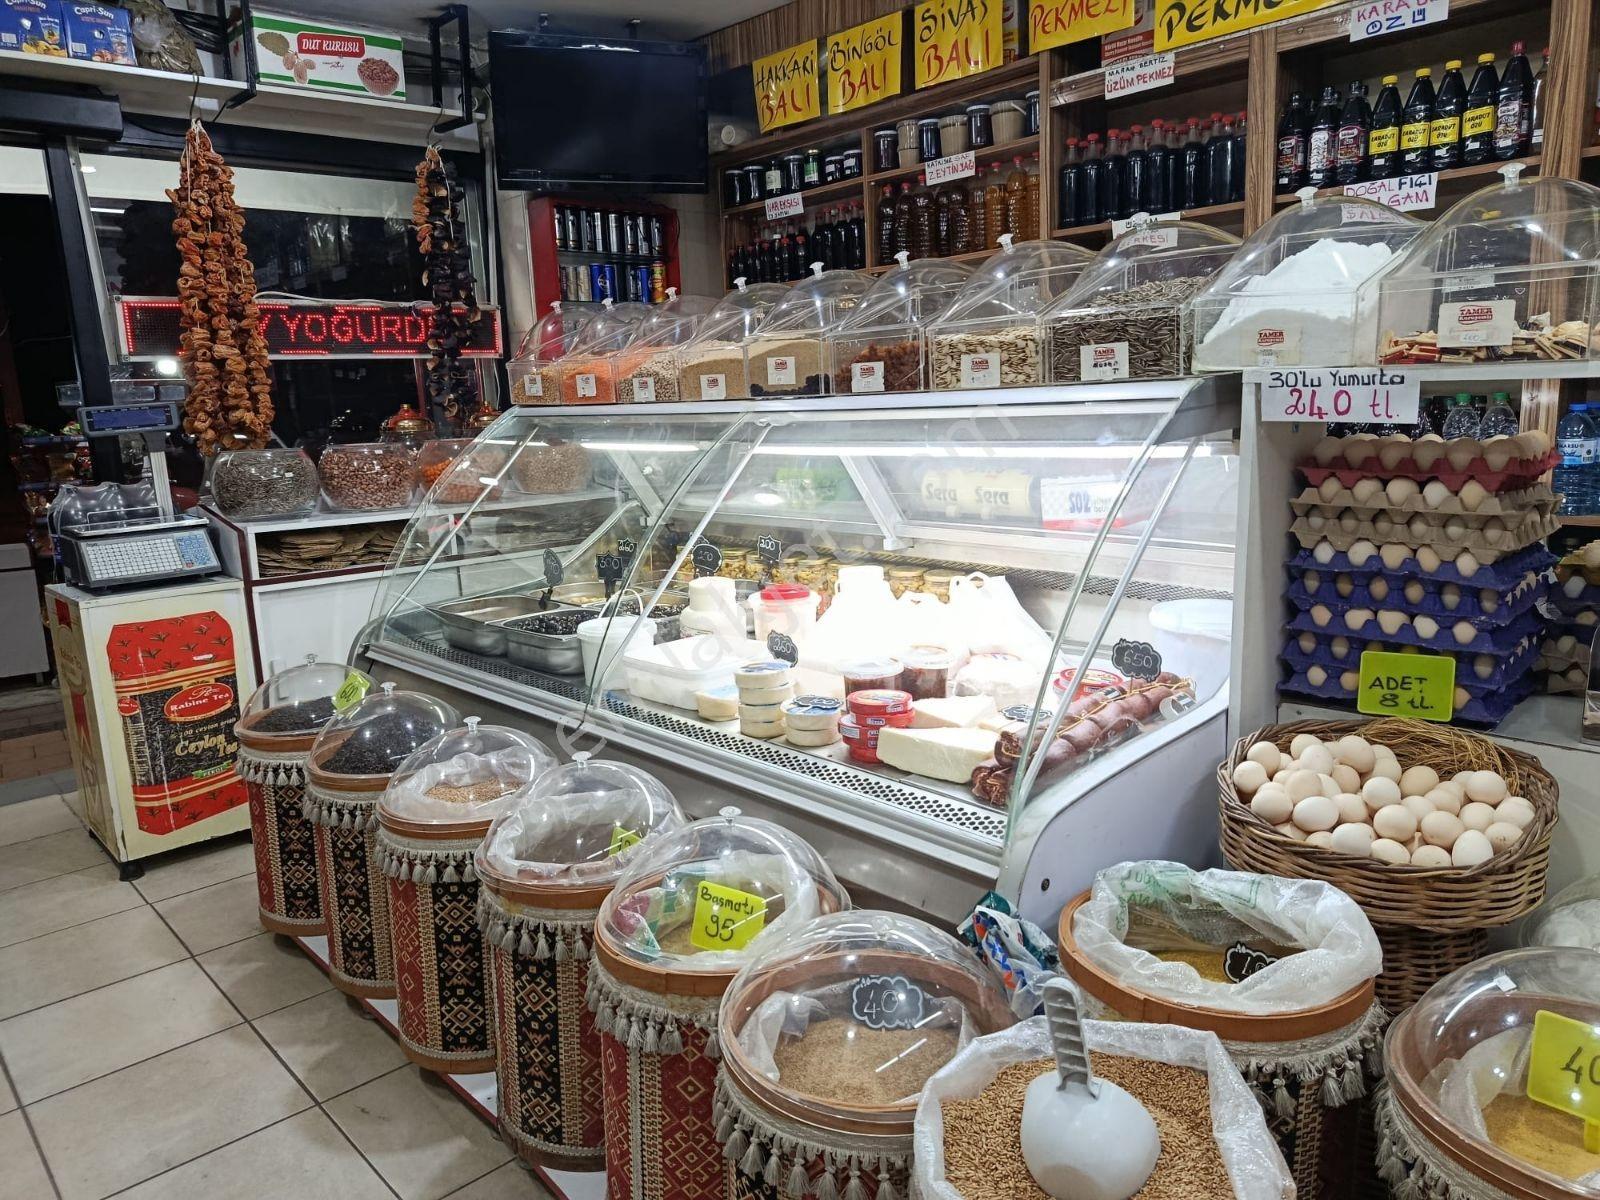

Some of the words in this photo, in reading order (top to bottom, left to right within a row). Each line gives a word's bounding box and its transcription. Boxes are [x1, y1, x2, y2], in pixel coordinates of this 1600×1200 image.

[1160, 0, 1284, 42] PEKM
[302, 39, 320, 50] DUT
[322, 40, 360, 53] KURUSU
[922, 30, 990, 83] BALI
[833, 57, 887, 107] BALI
[1106, 75, 1135, 94] ÜZÜM
[759, 82, 811, 127] BALI
[1346, 180, 1395, 197] DOĞAL
[1398, 174, 1432, 191] FIÇI
[1460, 307, 1493, 316] TAMER
[280, 308, 435, 342] YOĞURD
[1329, 368, 1406, 386] Yumurta
[1285, 388, 1351, 419] 240
[1123, 648, 1153, 668] 650
[1368, 676, 1428, 692] ADET
[1378, 693, 1399, 707] 8
[175, 733, 226, 756] Ceylon
[216, 741, 239, 758] Tea
[705, 914, 735, 942] 95
[863, 989, 899, 1020] 40
